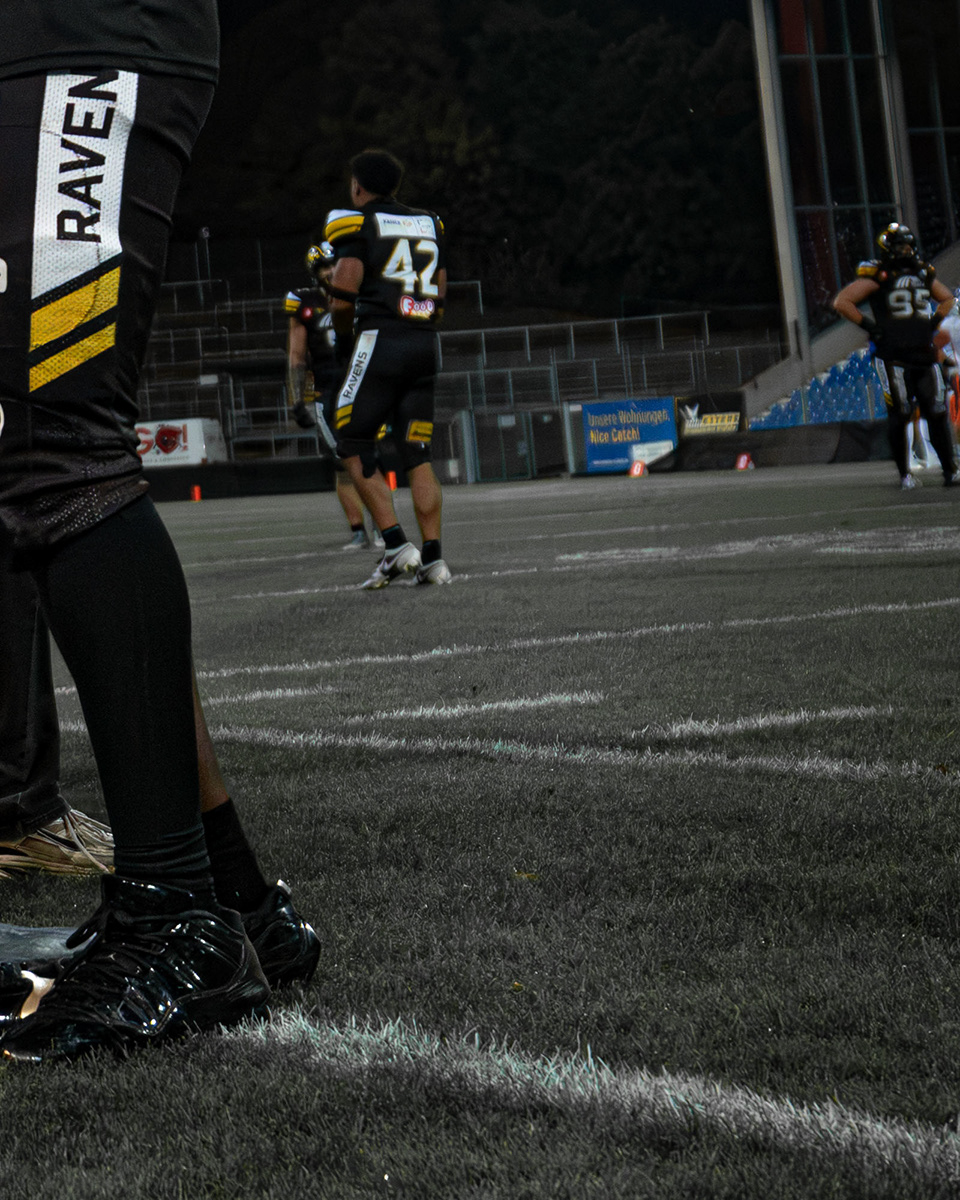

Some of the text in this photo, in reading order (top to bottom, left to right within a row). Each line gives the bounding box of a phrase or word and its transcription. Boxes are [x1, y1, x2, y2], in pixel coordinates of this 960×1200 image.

[382, 238, 439, 297] 42
[343, 351, 368, 400] RAVENS
[590, 429, 610, 445] Nice
